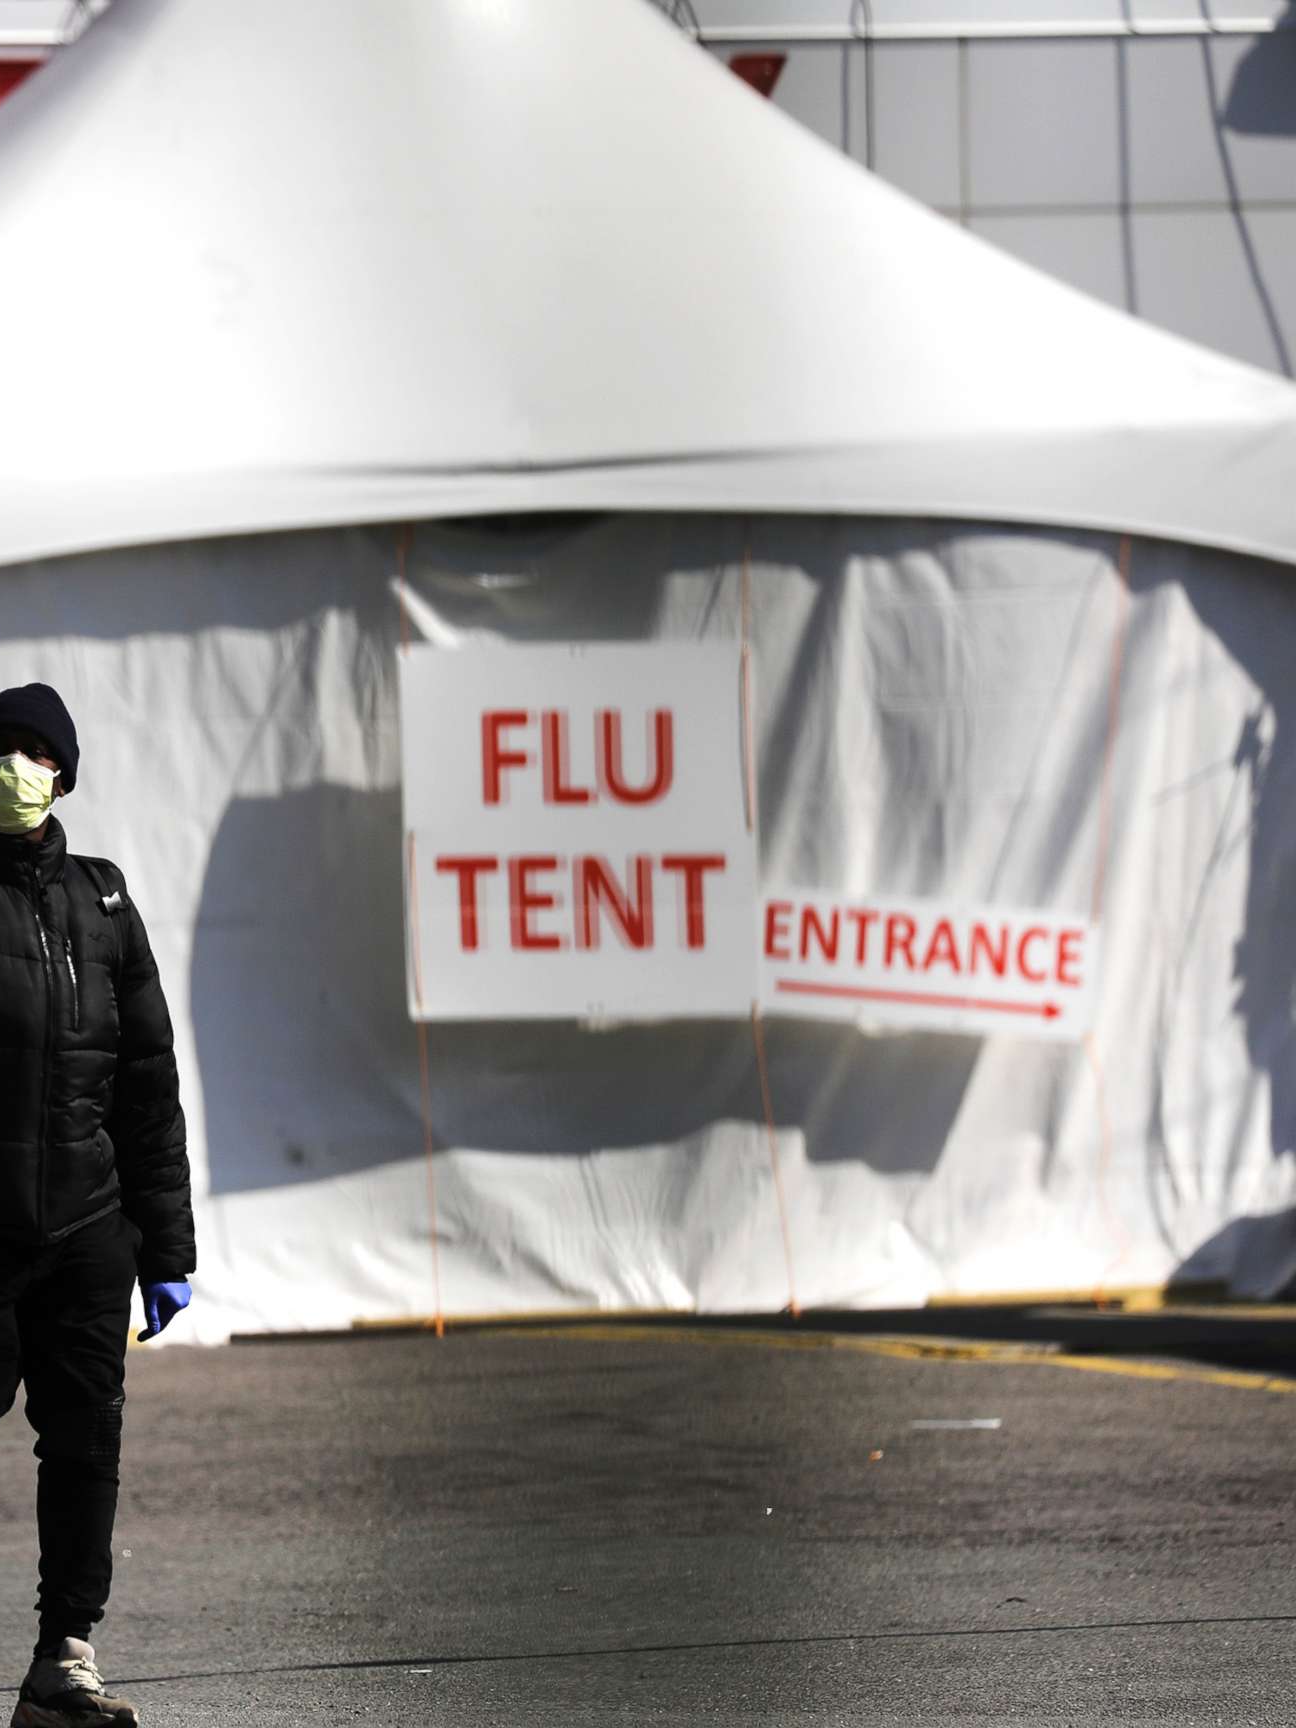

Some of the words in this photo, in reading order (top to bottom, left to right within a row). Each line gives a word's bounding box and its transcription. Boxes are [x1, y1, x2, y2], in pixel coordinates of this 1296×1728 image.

[480, 709, 675, 806] FLU
[435, 854, 727, 953] TENT
[762, 900, 1085, 986] ENTRANCE
